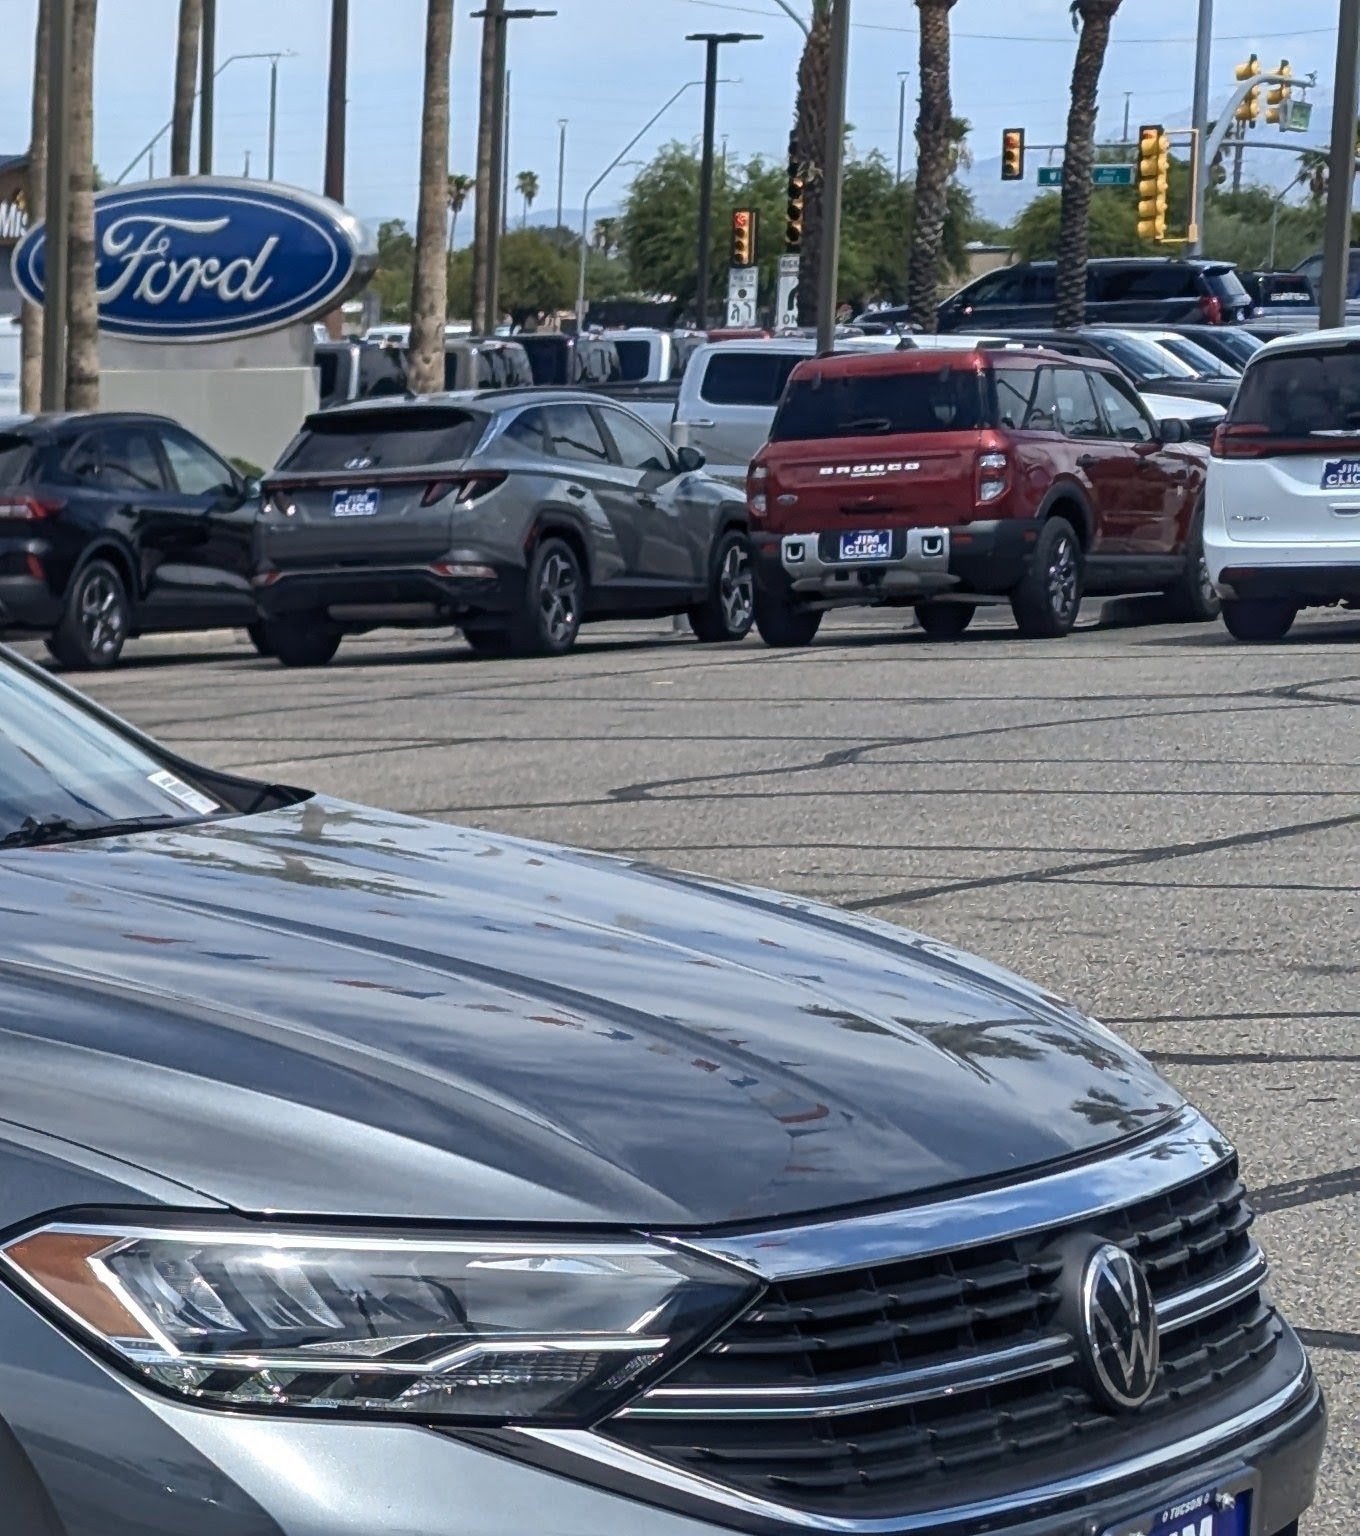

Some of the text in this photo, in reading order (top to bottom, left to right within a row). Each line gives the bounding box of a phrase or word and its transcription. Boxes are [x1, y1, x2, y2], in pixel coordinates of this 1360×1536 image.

[95, 214, 279, 305] Ford
[819, 462, 920, 475] BRONCO
[1326, 473, 1360, 485] CLIC
[853, 534, 880, 545] JIM
[844, 543, 888, 555] CLICK
[1168, 1494, 1205, 1521] TUCSON
